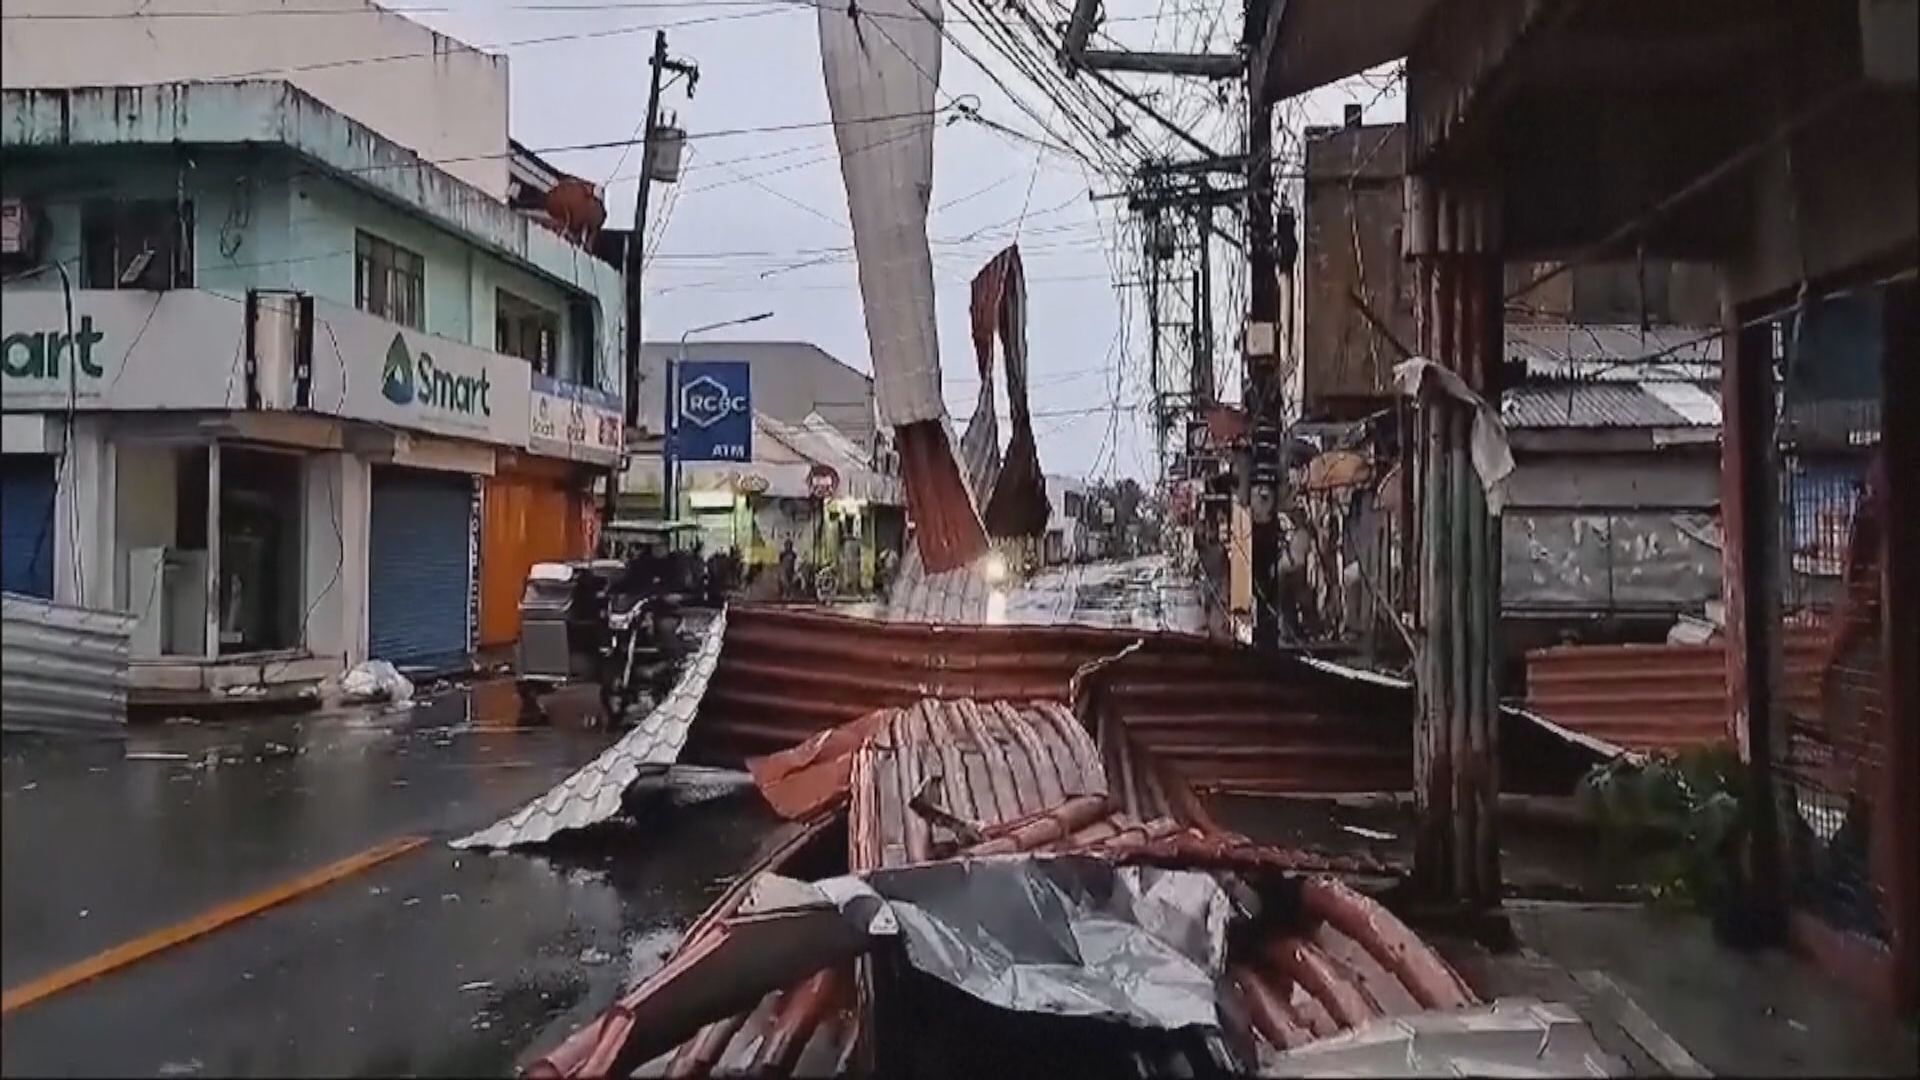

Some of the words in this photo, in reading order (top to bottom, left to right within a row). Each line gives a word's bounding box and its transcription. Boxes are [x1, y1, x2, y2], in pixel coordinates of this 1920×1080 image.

[418, 352, 490, 417] Smart
[690, 395, 746, 412] RCBC
[712, 444, 745, 458] ATM
